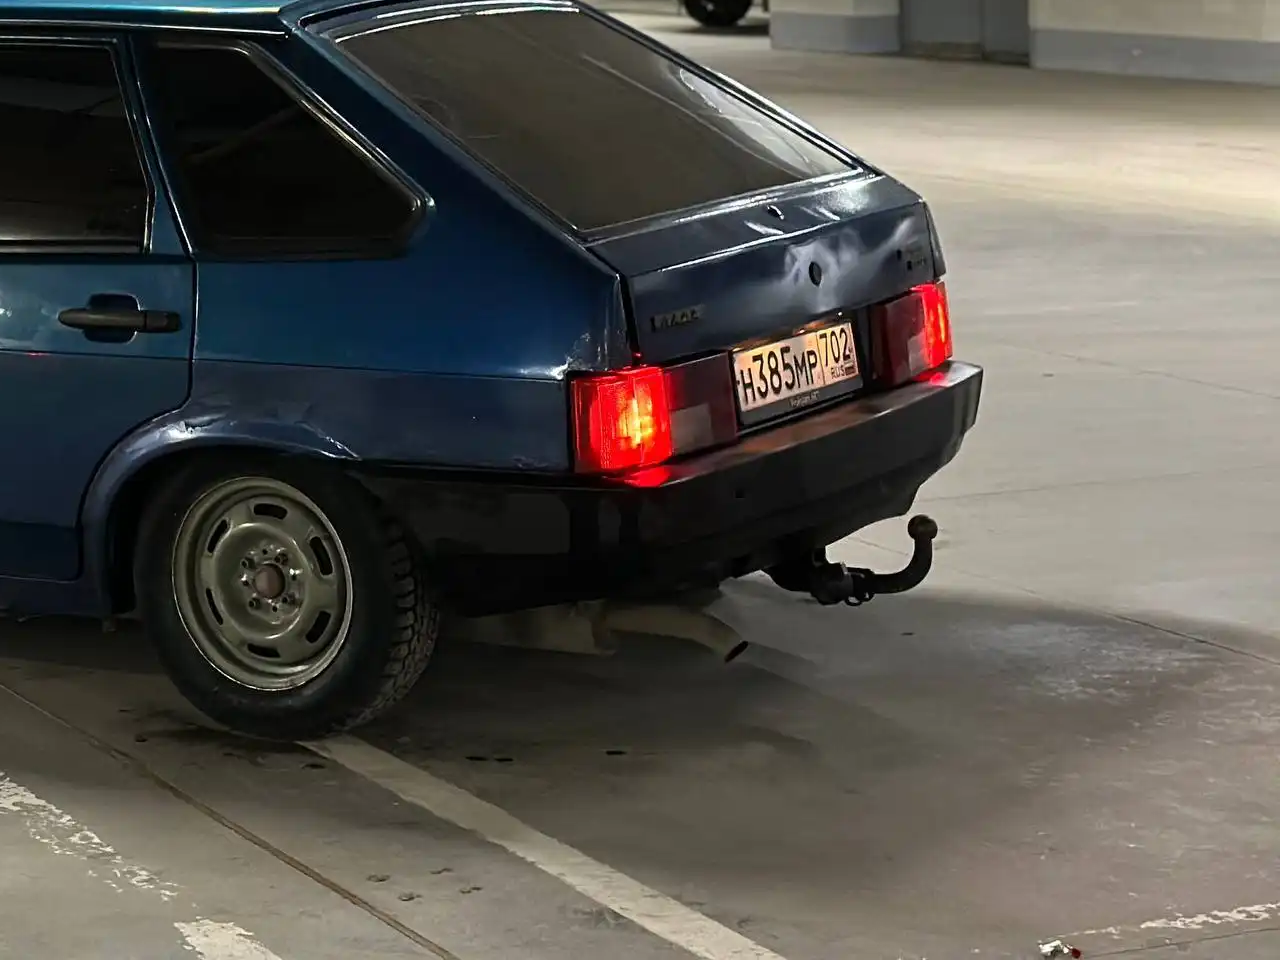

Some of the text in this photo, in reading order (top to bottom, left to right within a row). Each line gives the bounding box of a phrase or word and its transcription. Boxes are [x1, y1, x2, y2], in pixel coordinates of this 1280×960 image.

[739, 327, 851, 406] Н385МР 702
[830, 364, 846, 380] RUS
